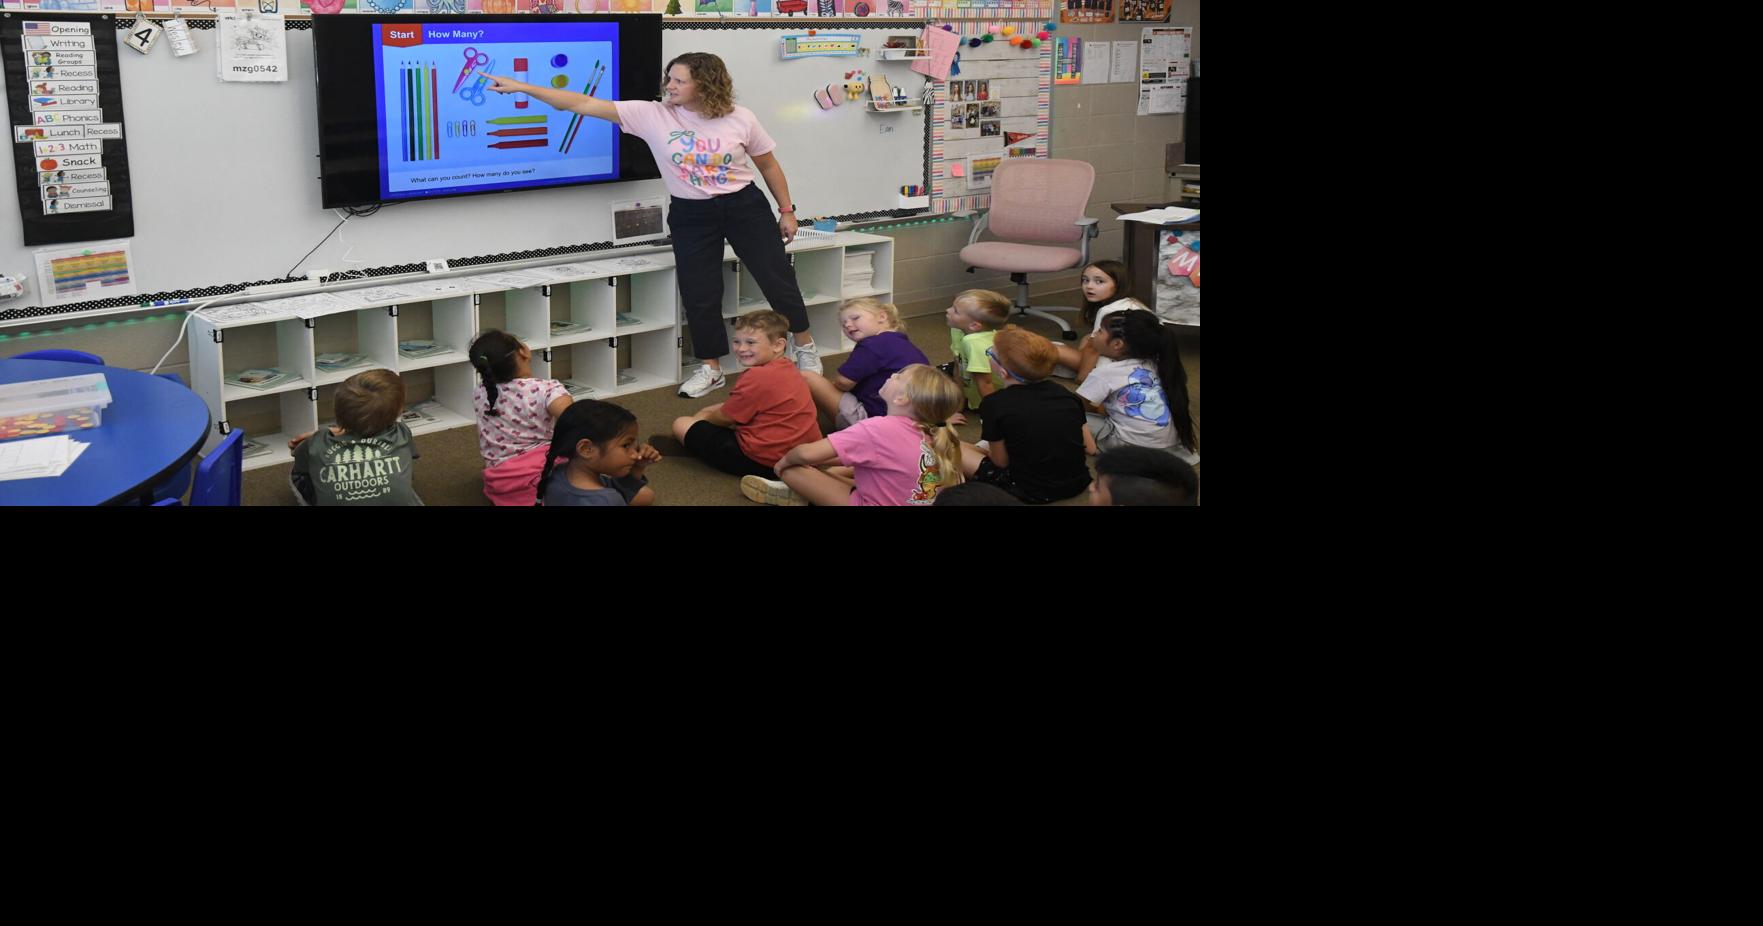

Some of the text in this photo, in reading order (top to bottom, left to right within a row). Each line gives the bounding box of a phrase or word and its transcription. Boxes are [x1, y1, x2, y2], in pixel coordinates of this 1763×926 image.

[52, 26, 89, 34] Opening
[134, 28, 152, 46] 4
[390, 31, 415, 39] Start
[428, 30, 484, 40] How Many?
[50, 40, 85, 48] Writing
[232, 65, 278, 74] mzg0542
[58, 84, 94, 92] Reading
[60, 97, 95, 106] Library
[37, 113, 99, 124] ABC Phonics
[50, 129, 80, 137] Lunch
[69, 143, 97, 151] Math
[62, 156, 96, 166] Snack
[672, 152, 708, 166] CAN
[71, 172, 102, 180] Recess
[64, 200, 104, 209] Dismissal
[1172, 252, 1199, 271] M
[319, 456, 401, 483] CARHARTT
[334, 475, 389, 491] OUTDOORS
